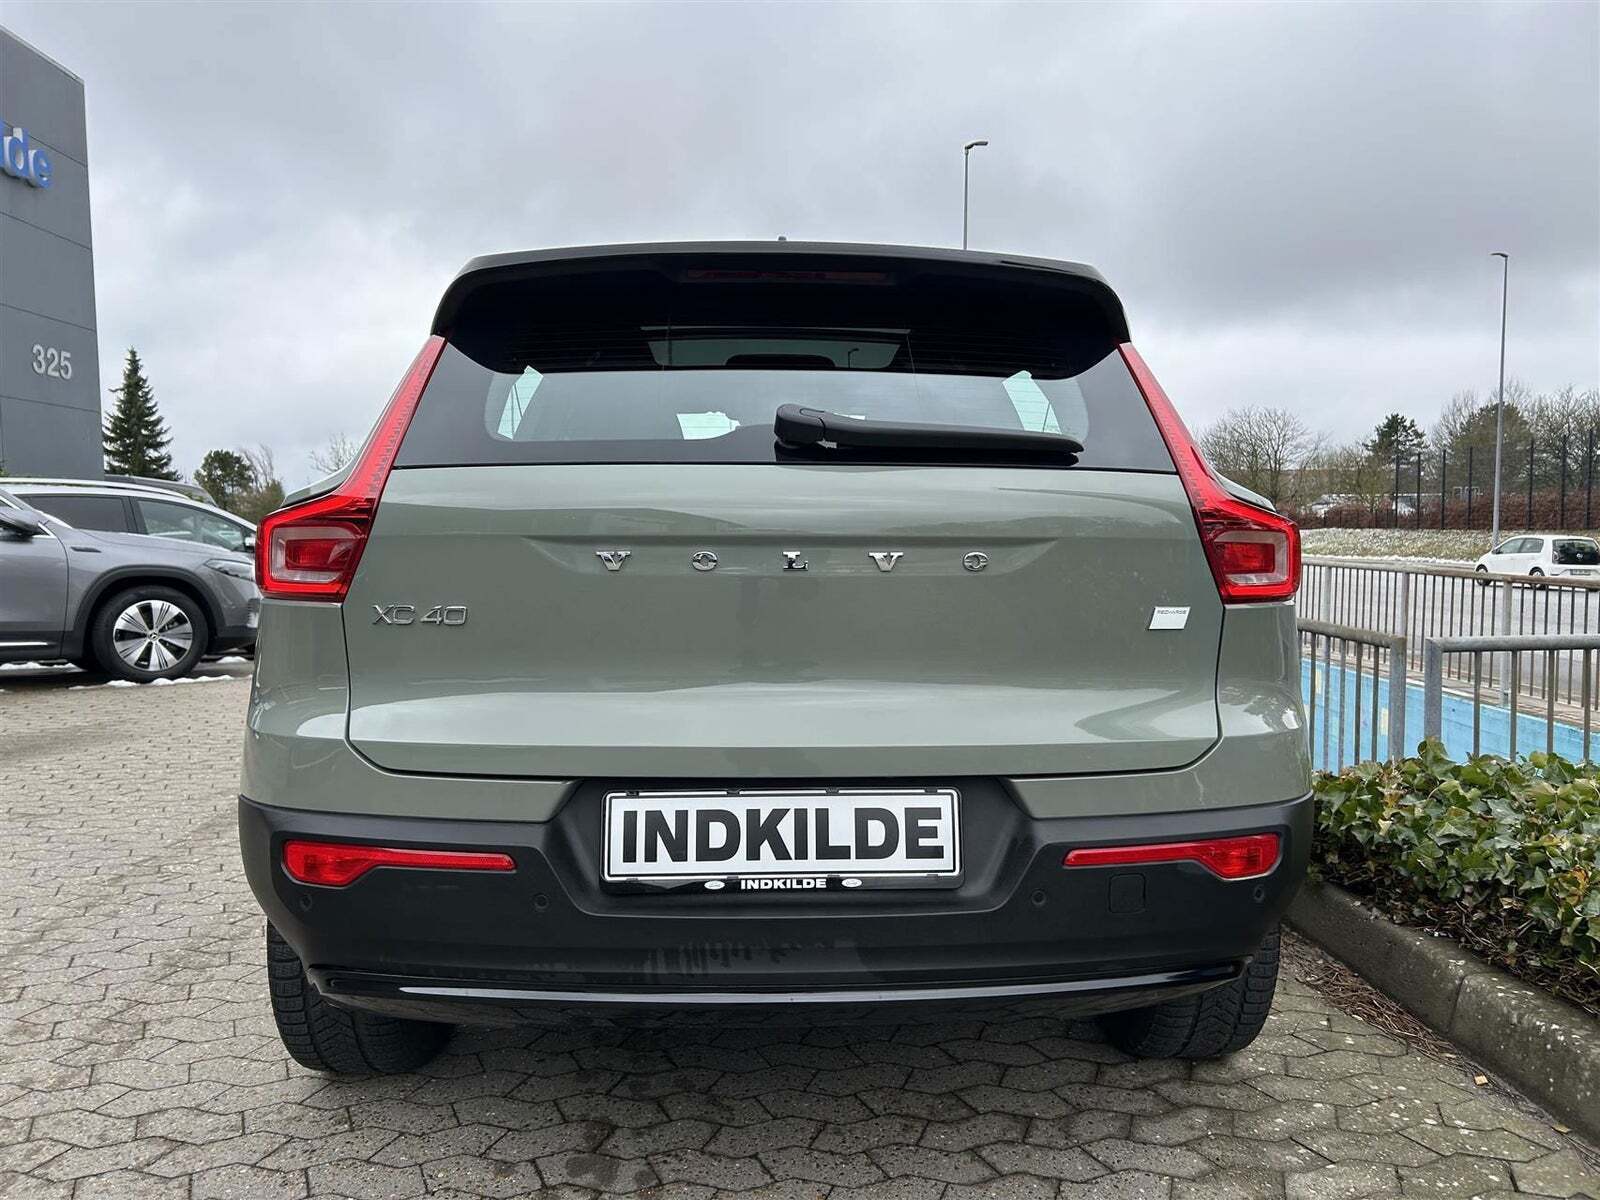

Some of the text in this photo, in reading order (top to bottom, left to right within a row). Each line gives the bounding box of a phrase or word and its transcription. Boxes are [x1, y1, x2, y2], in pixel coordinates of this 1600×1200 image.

[32, 343, 72, 380] 325
[596, 551, 989, 572] VOLVO
[372, 604, 467, 625] XC 40
[622, 807, 945, 863] INDKILDE
[740, 878, 827, 889] INDKILDE
